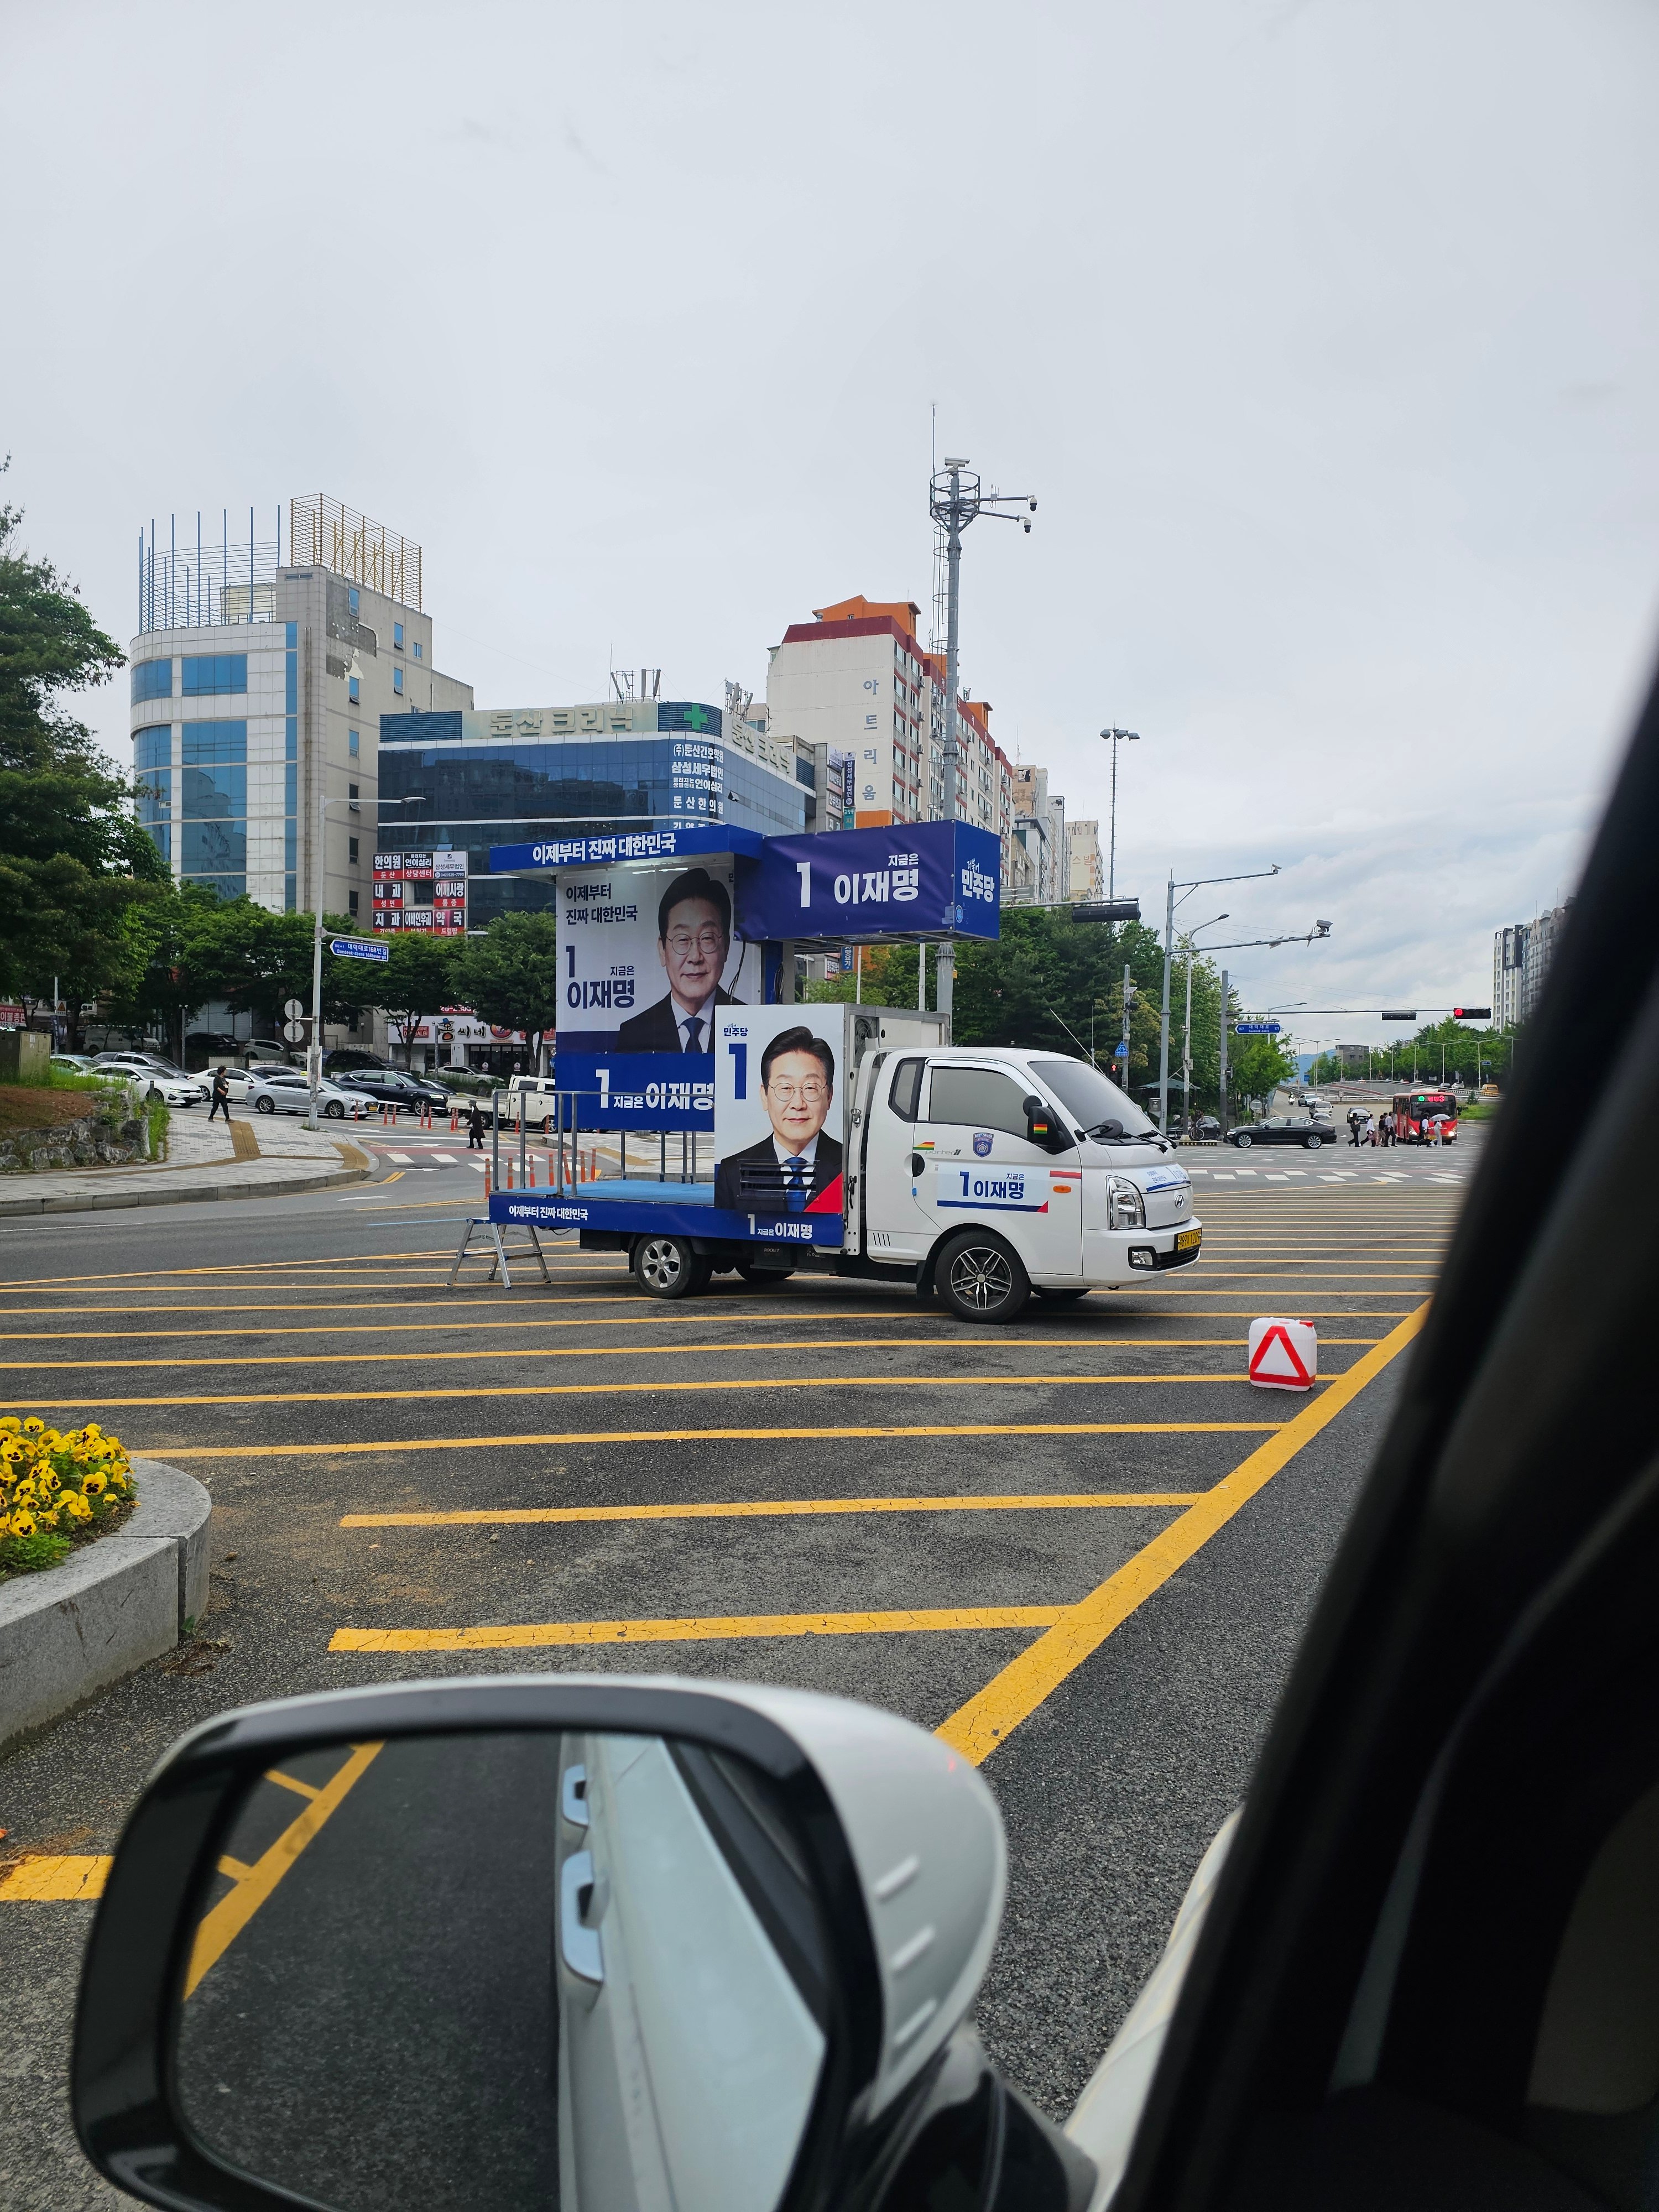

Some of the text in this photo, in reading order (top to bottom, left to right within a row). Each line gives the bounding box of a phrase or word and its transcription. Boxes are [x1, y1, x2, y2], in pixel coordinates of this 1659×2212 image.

[491, 706, 633, 738] 둔산 크리닉
[732, 719, 754, 754] 둔산
[863, 679, 879, 801] 아트리움
[673, 743, 724, 764] (주)둔산간호학원
[671, 761, 723, 780] 삼성세무법인
[695, 778, 722, 794] 언어심리
[533, 832, 676, 864] 이제부터 진짜 대한민국
[374, 855, 401, 869] 한의원
[405, 858, 432, 867] 언어심리
[888, 853, 919, 867] 지금은
[405, 869, 432, 878] 상담센터
[436, 883, 464, 898] 어깨사랑
[566, 883, 612, 902] 이제부터
[796, 862, 919, 907] 1 이재명
[962, 869, 995, 902] 민주당
[405, 912, 431, 926] 이비인후과
[566, 905, 638, 925] 진짜 대한민국
[347, 943, 387, 956] 대덕대로168번길
[566, 945, 575, 978] 1
[610, 966, 634, 977] 지금은
[567, 979, 635, 1009] 이재명
[723, 1027, 748, 1037] 민주당
[728, 1044, 747, 1099] 1
[596, 1069, 714, 1111] 1 지금은 이재명
[959, 1171, 1024, 1199] 1 이재명
[509, 1205, 589, 1221] 이제부터 진짜 대한민국
[747, 1213, 755, 1235] 1
[775, 1222, 812, 1239] 이재명
